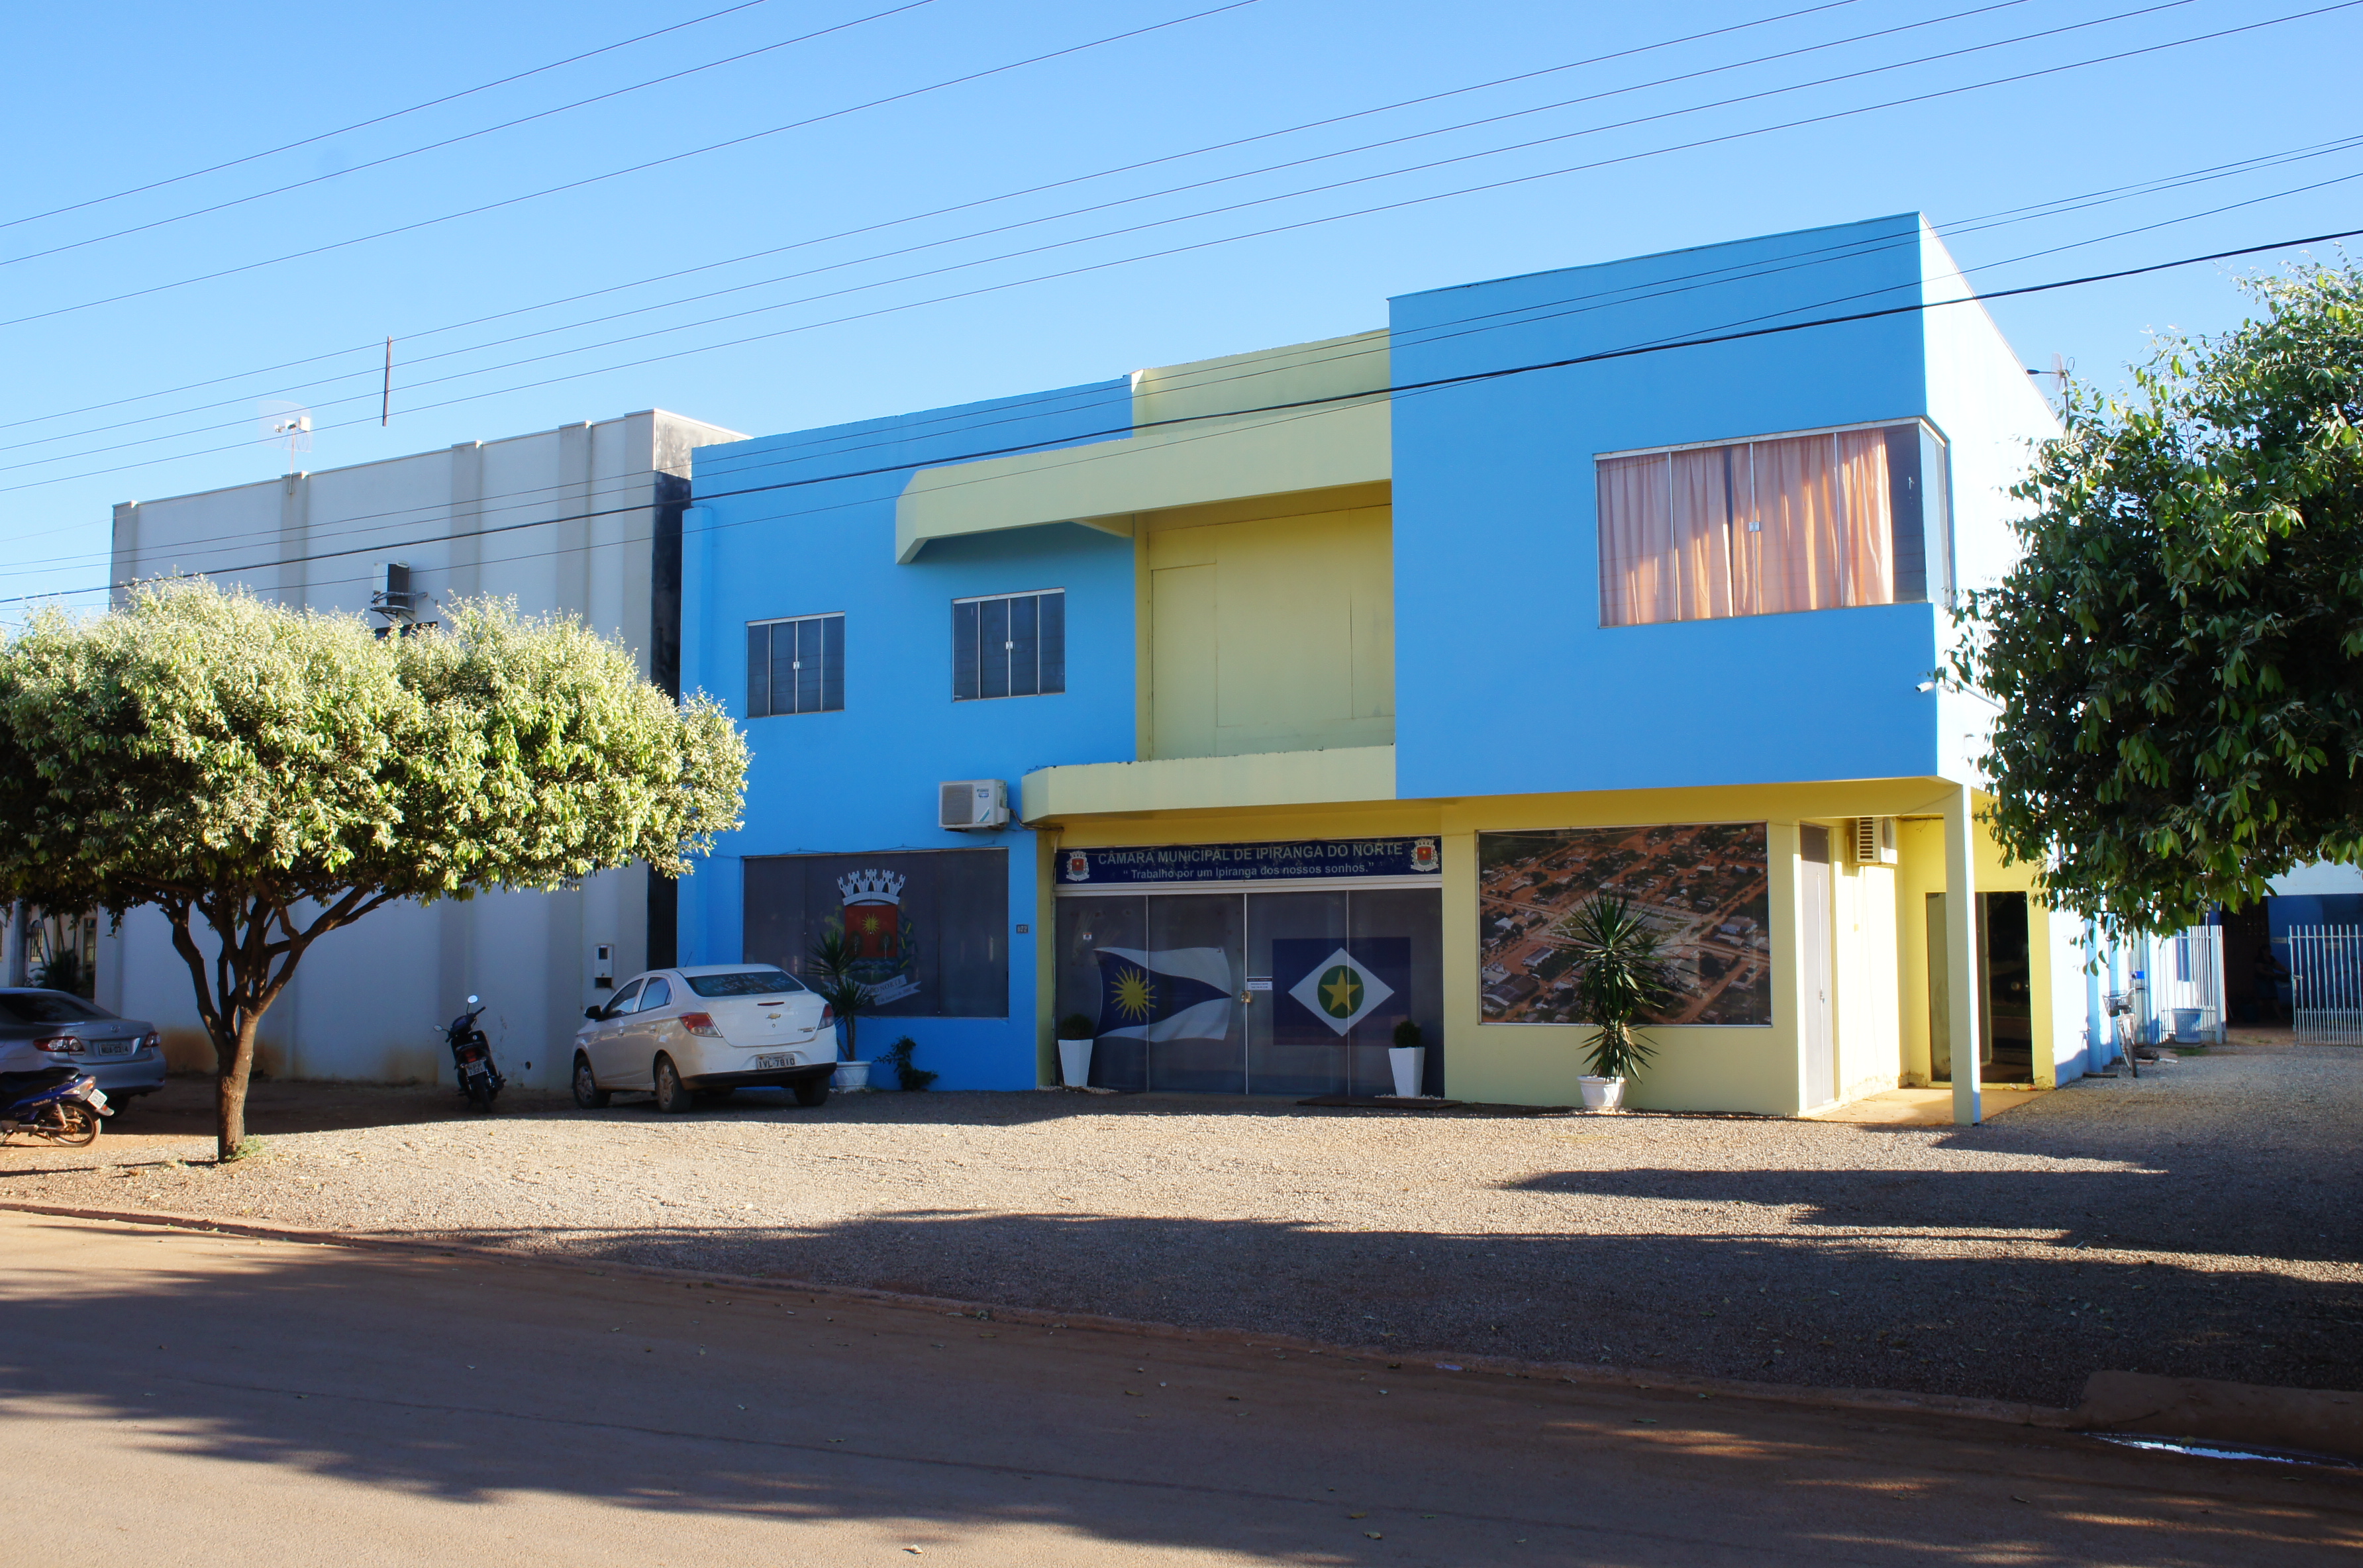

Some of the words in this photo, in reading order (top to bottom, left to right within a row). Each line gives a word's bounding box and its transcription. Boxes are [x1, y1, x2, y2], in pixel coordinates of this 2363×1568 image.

[1098, 851, 1154, 864] CÂMARA
[1158, 850, 1230, 863] MUNICIPAL
[1234, 848, 1252, 860] DE
[1256, 846, 1324, 859] IPIRANGA
[1327, 844, 1348, 857] DO
[1352, 842, 1403, 856] NORTE
[1131, 869, 1174, 879] Trabalho
[1177, 870, 1194, 879] por
[1197, 869, 1213, 877] um
[1216, 866, 1257, 879] Ipiranga
[1260, 865, 1280, 875] dos
[1283, 865, 1322, 875] nossos
